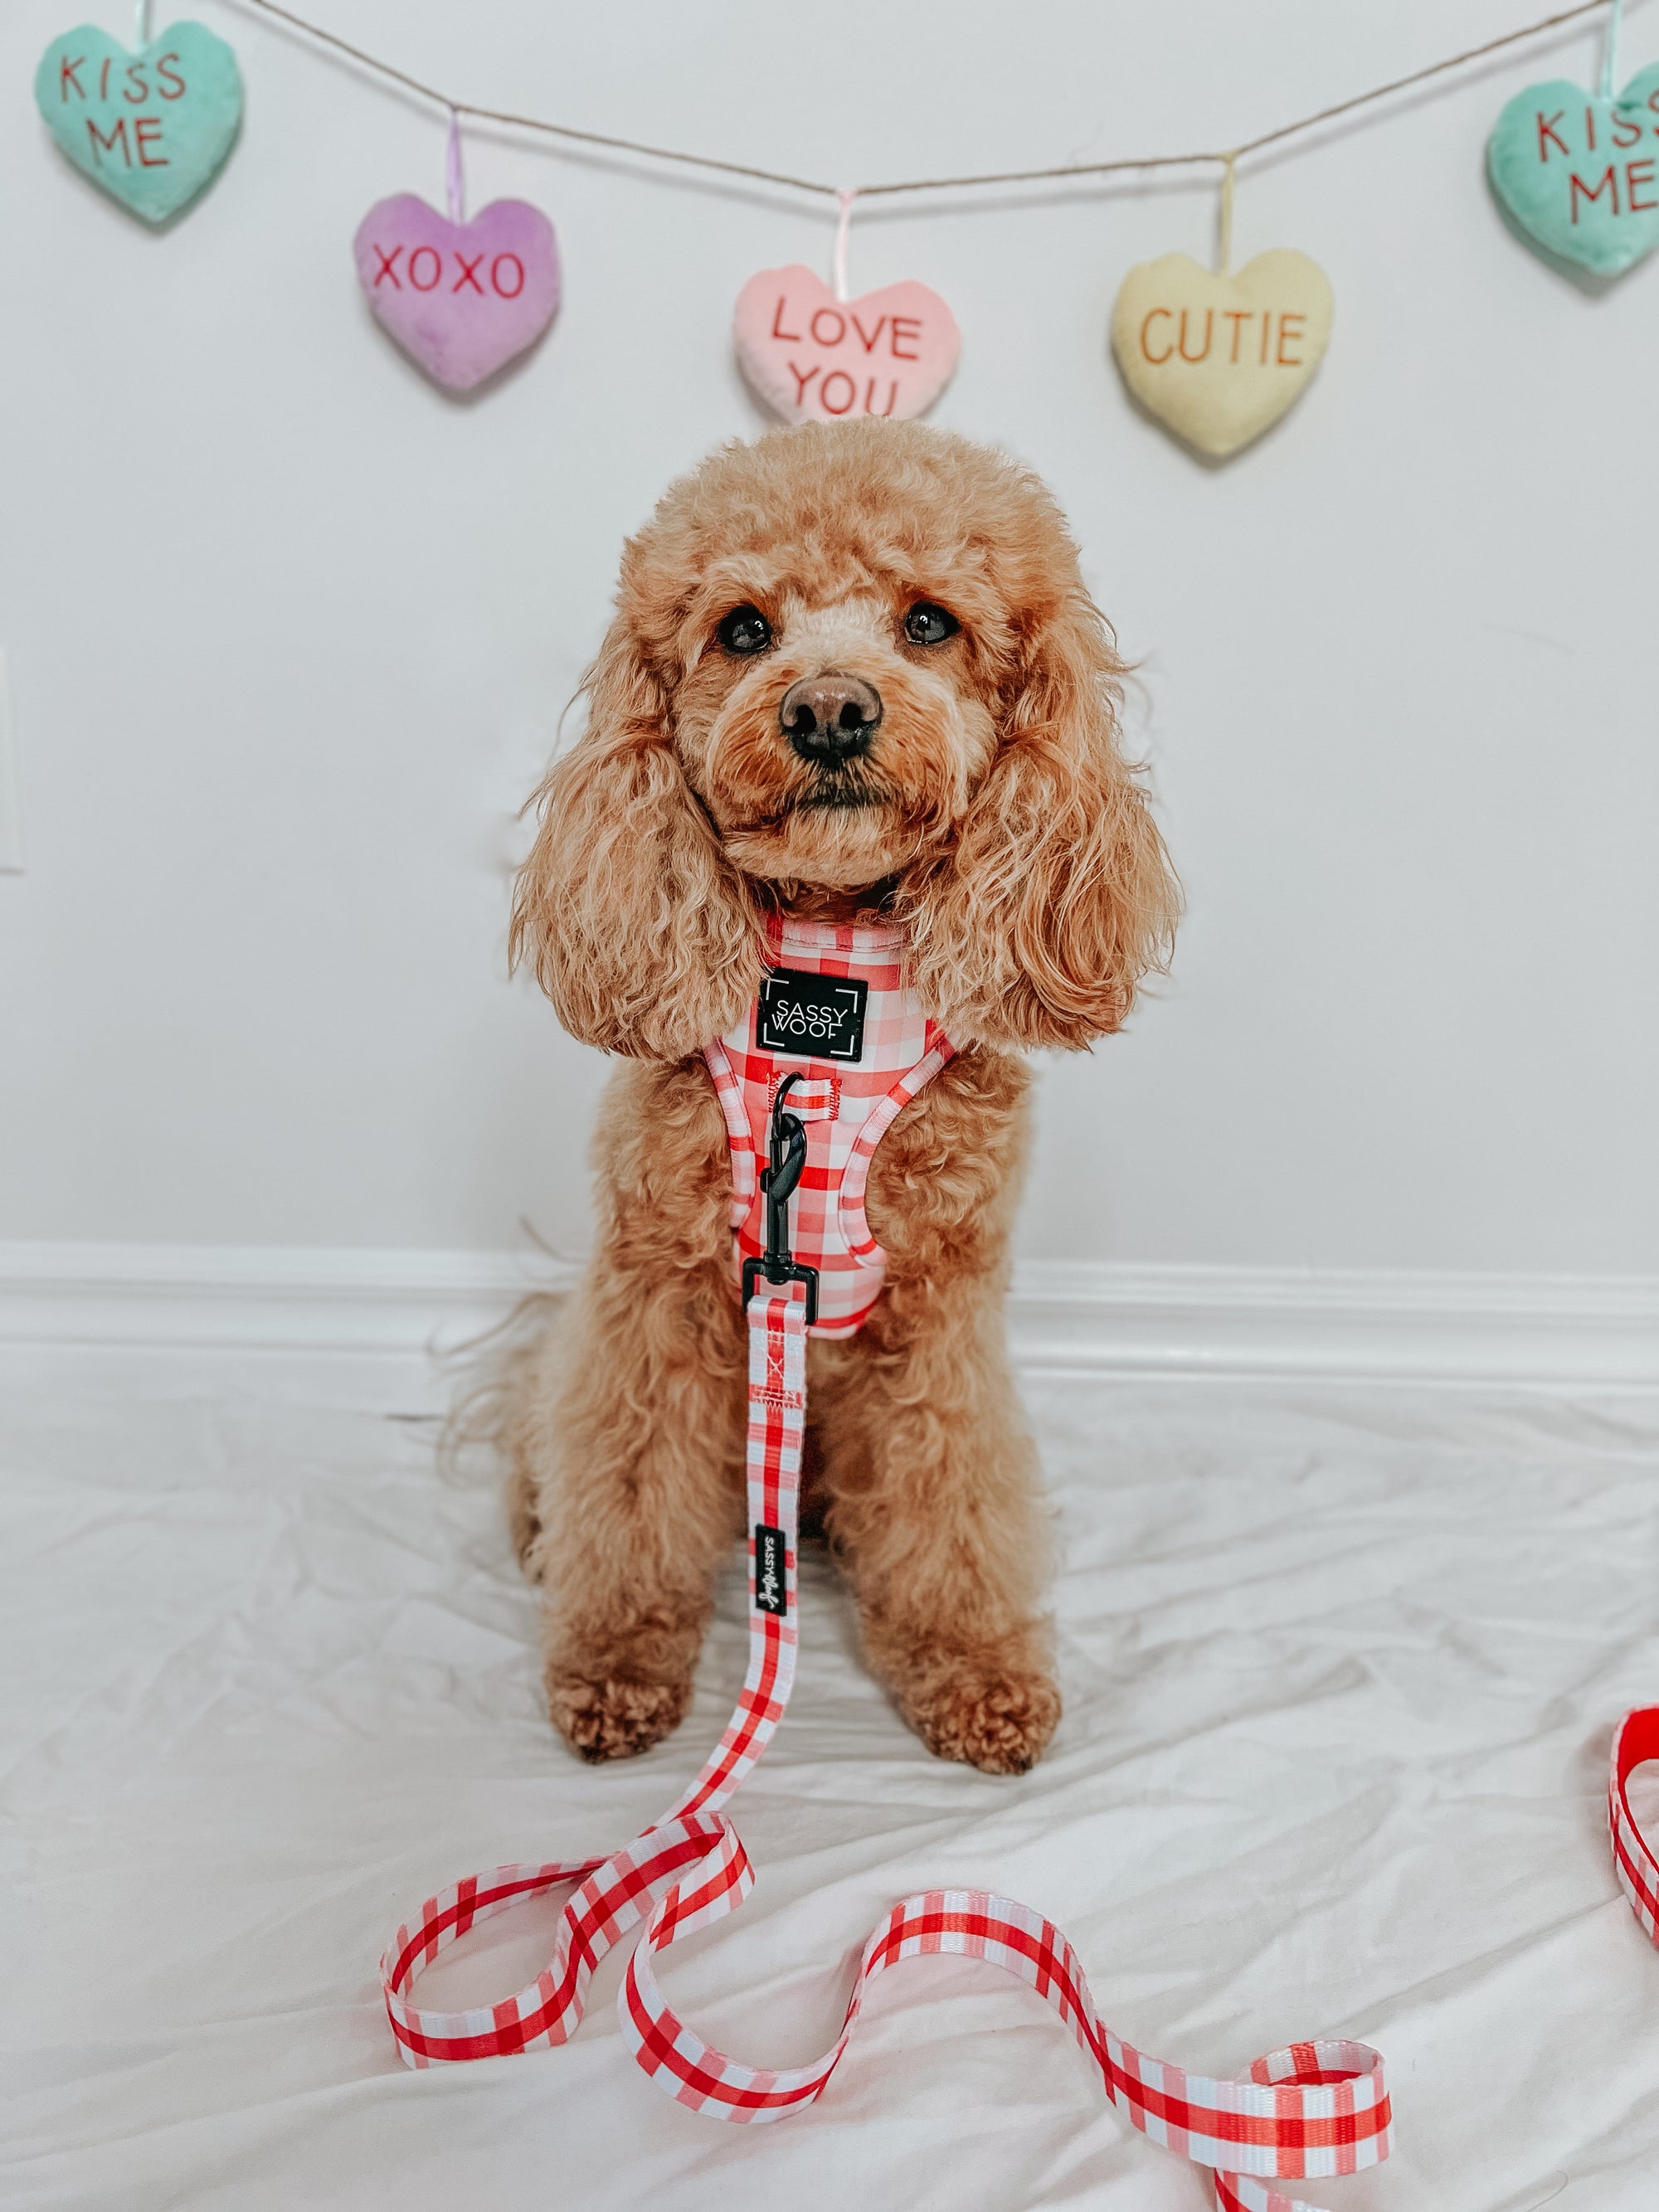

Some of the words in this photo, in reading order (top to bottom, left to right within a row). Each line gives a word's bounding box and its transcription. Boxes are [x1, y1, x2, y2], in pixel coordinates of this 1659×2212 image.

[60, 52, 187, 103] KISS
[85, 117, 171, 168] ME
[1569, 158, 1659, 226] ME
[372, 242, 526, 300] XOXO
[771, 295, 922, 362] LOVE
[1139, 308, 1307, 367] CUTIE
[786, 361, 898, 418] YOU
[771, 1014, 843, 1039] WOOF
[776, 999, 848, 1024] SASSY
